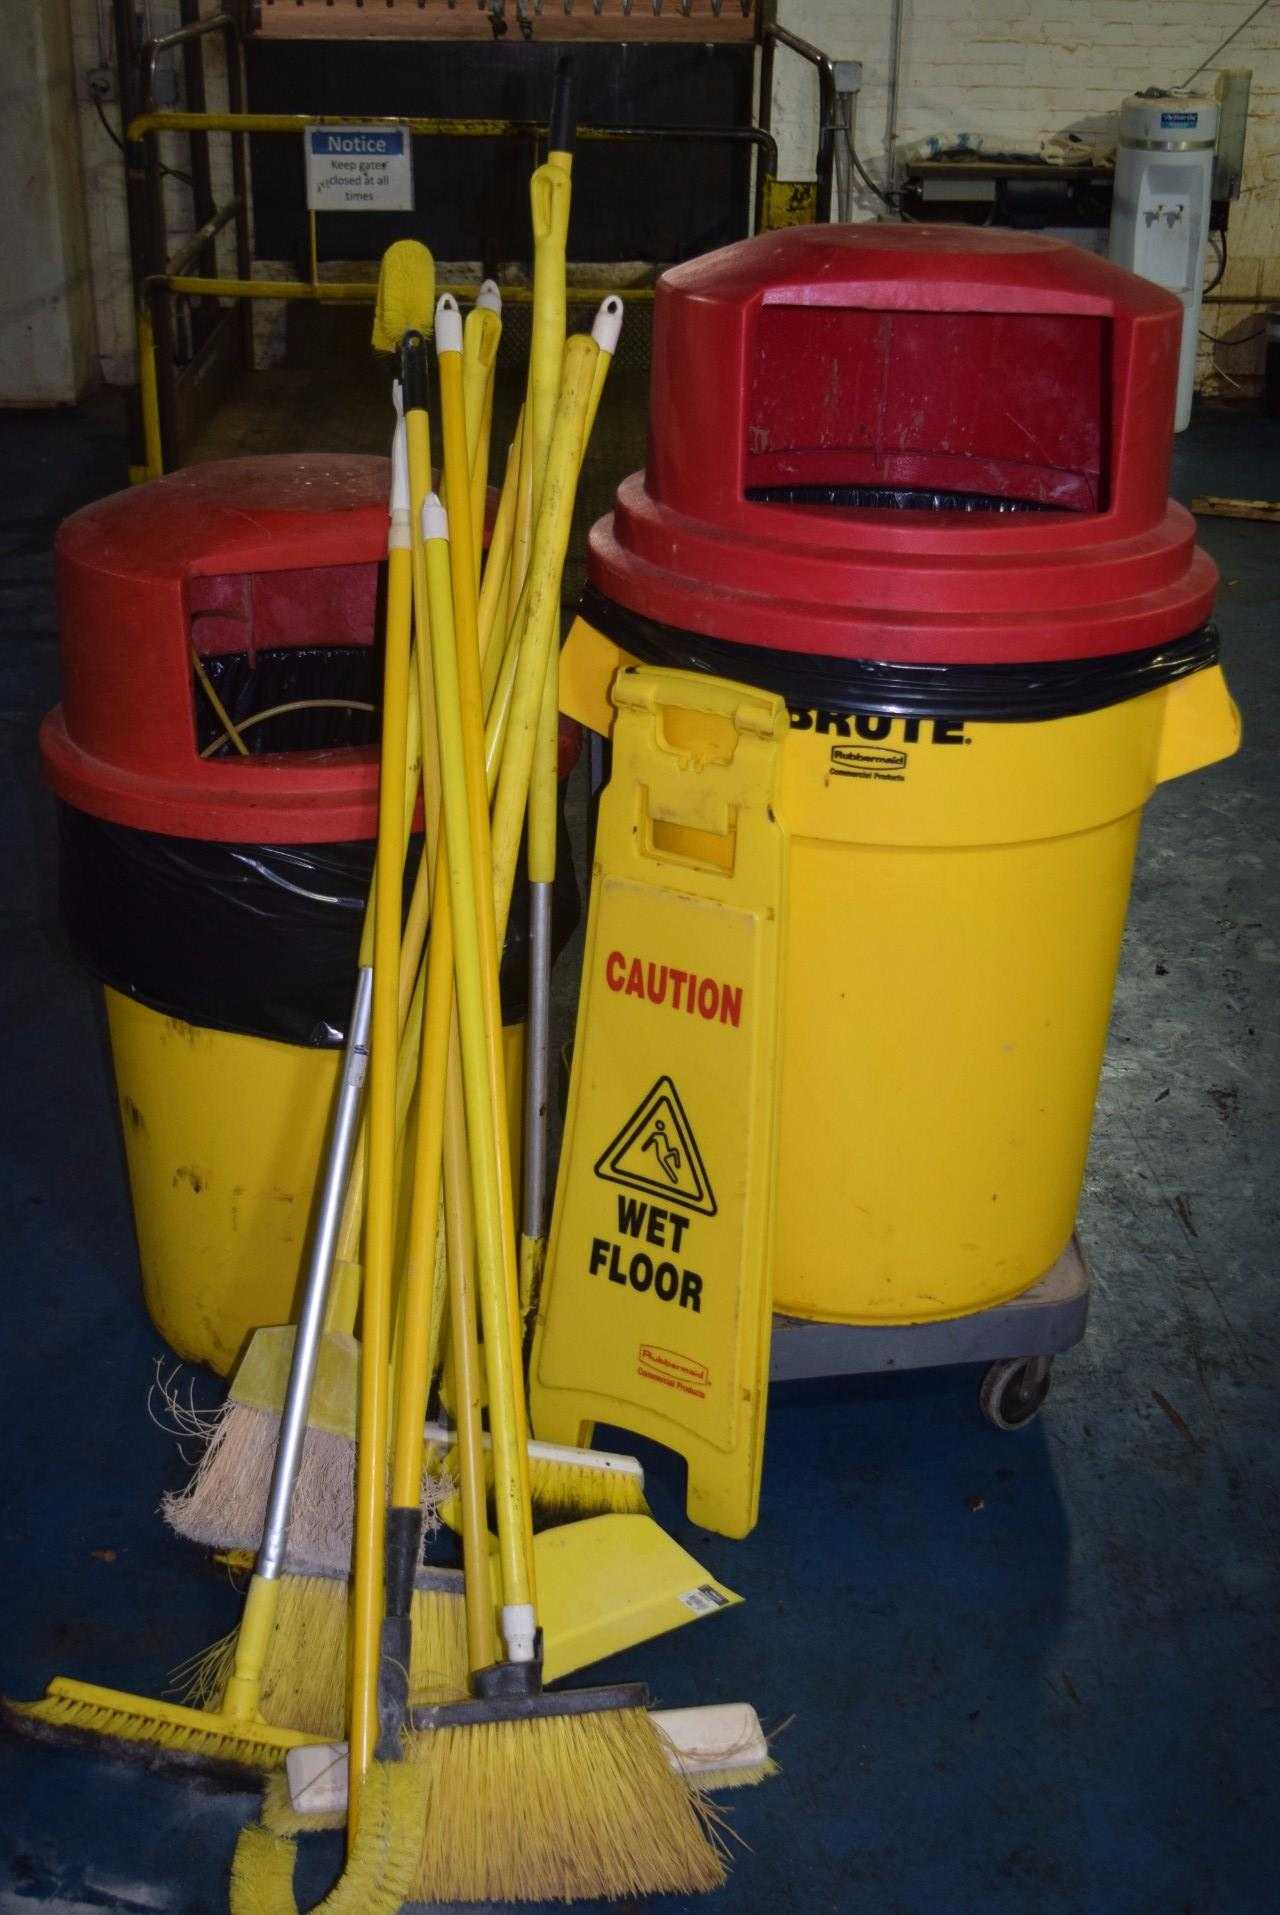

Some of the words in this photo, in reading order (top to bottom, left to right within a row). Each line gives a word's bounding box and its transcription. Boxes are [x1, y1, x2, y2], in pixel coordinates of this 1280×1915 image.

[328, 135, 387, 152] Notice
[330, 160, 357, 172] Keep
[329, 175, 361, 186] closed
[364, 176, 375, 186] at
[377, 175, 389, 186] all
[344, 191, 374, 201] times
[834, 750, 904, 765] Rubbermaid
[606, 950, 743, 1028] CAUTION
[617, 1194, 690, 1254] WET
[589, 1237, 703, 1314] FLOOR
[641, 1349, 705, 1379] Rubbermaid
